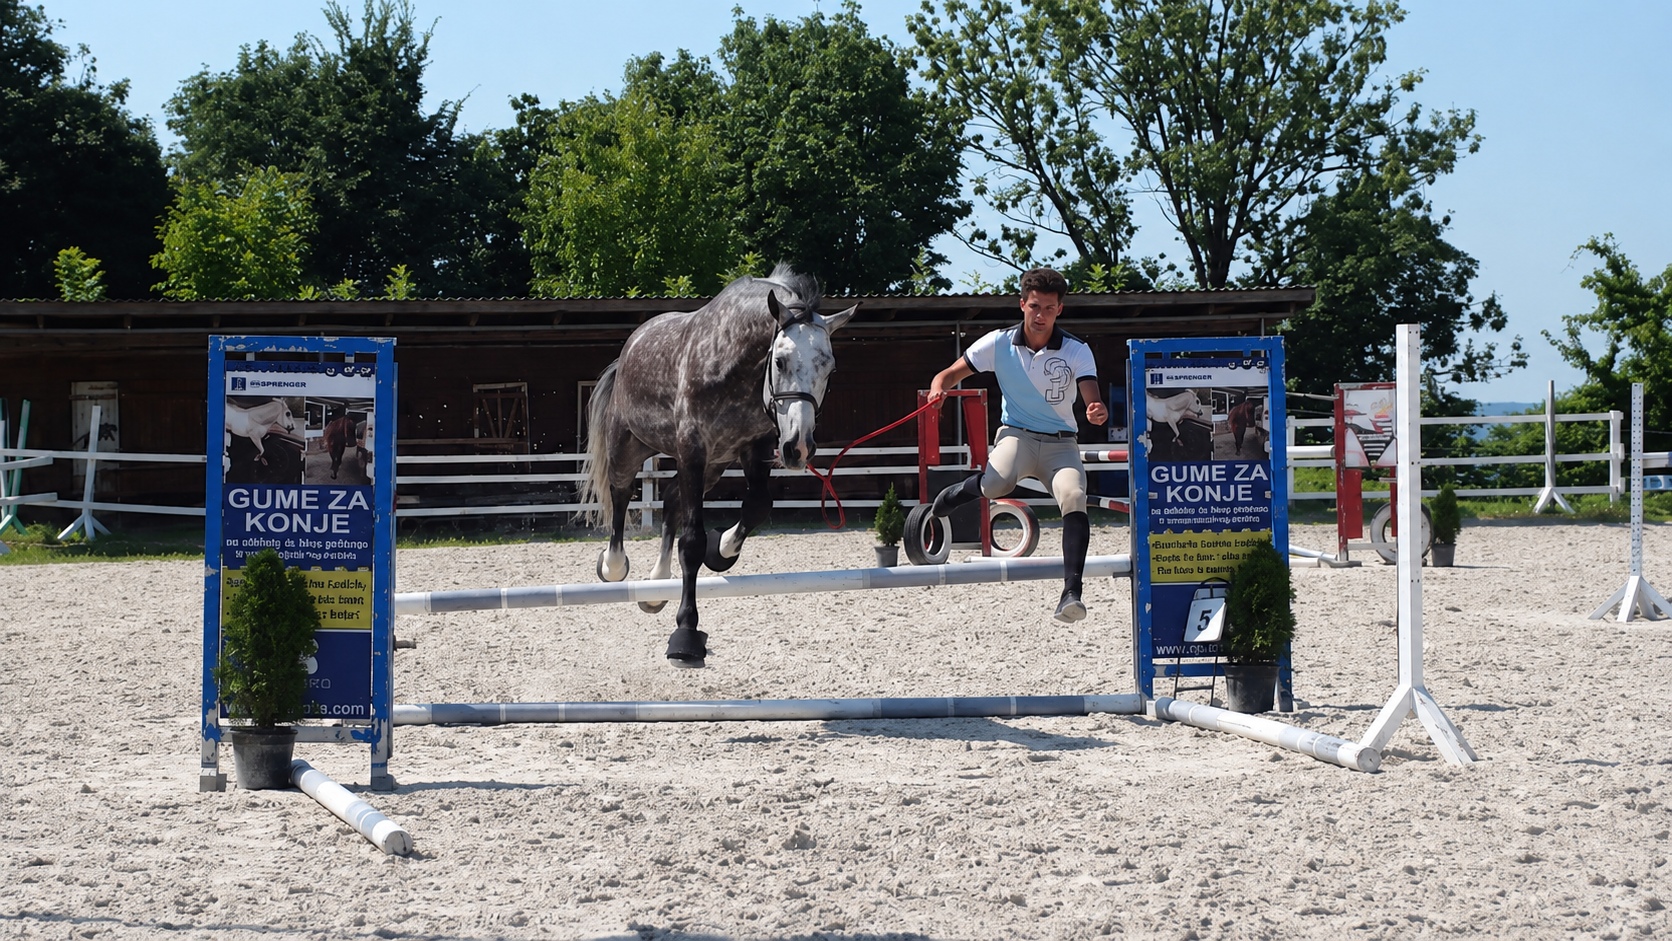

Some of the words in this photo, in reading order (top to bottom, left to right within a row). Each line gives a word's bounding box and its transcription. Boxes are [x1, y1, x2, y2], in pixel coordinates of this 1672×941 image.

[1151, 464, 1226, 483] GUME
[1234, 463, 1268, 481] ZA
[228, 488, 319, 510] GUME
[328, 489, 370, 511] ZA
[1166, 484, 1253, 503] KONJE
[245, 512, 350, 534] KONJE
[1197, 609, 1212, 632] 5
